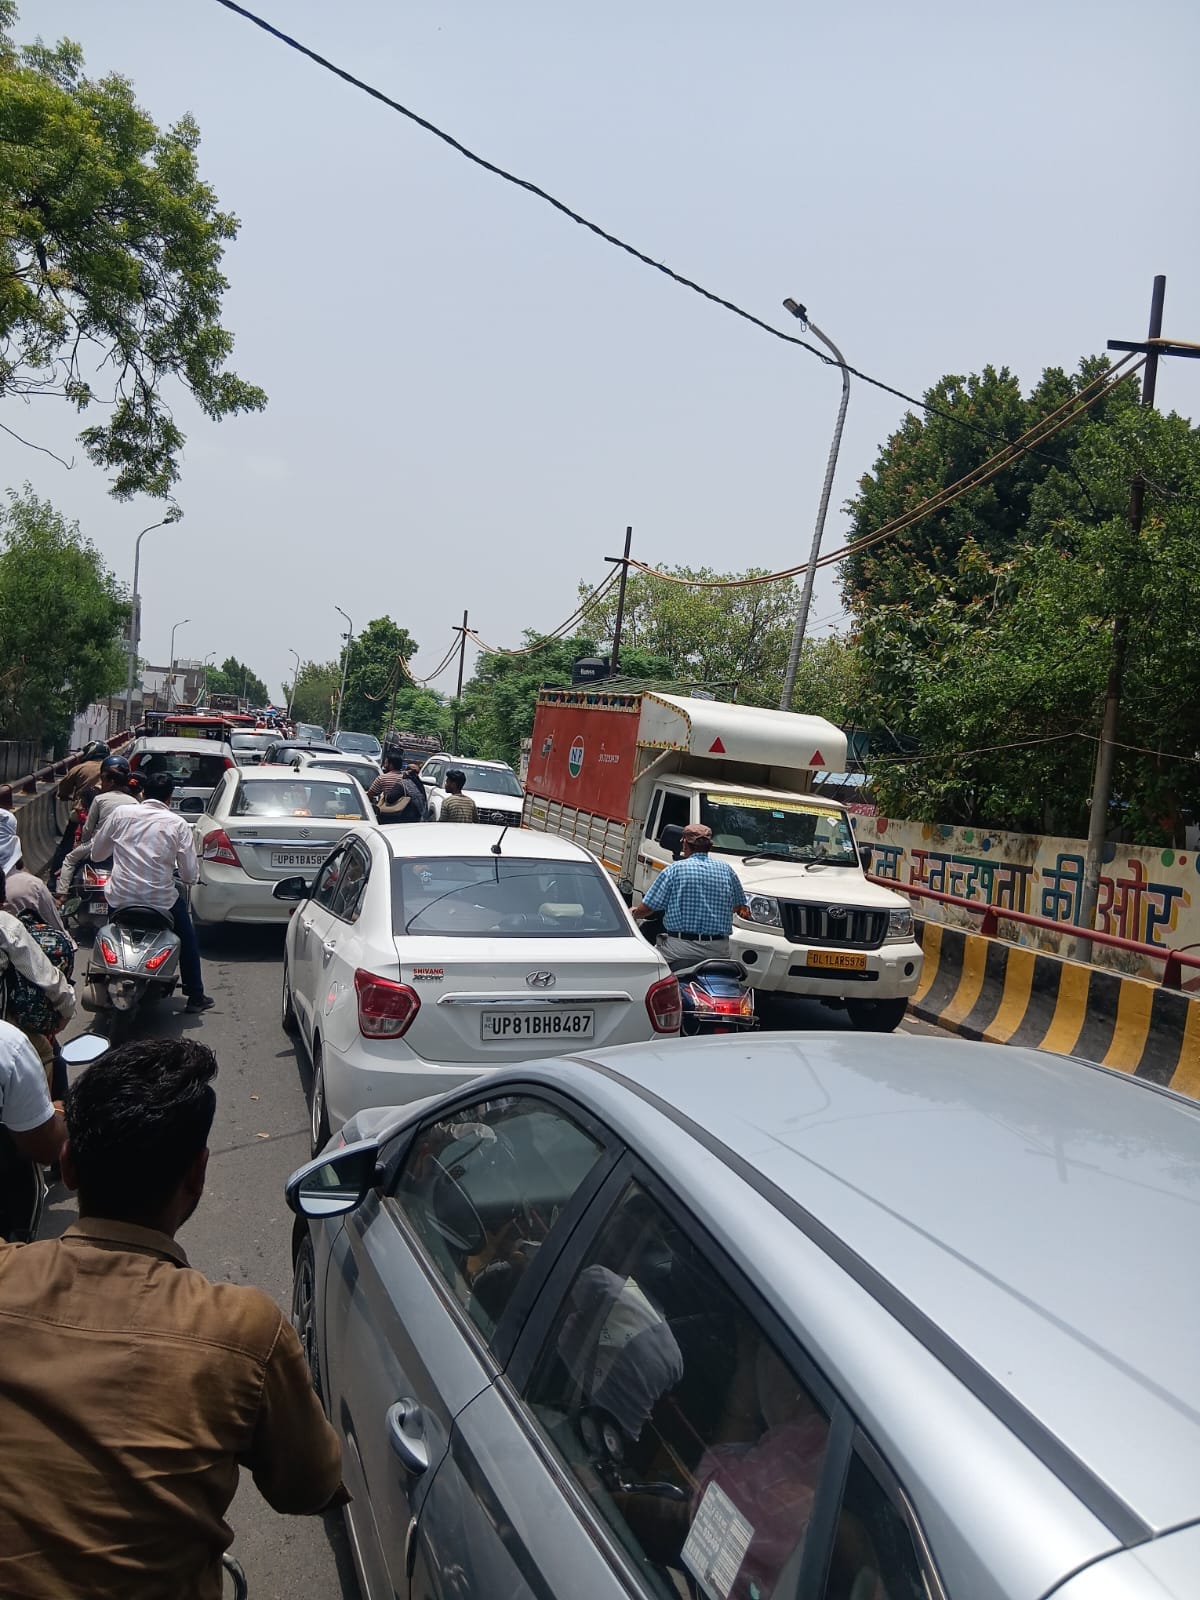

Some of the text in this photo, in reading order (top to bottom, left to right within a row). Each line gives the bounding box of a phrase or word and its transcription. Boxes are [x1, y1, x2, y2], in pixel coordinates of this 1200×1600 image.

[277, 855, 328, 865] UP81BA585
[1042, 853, 1085, 925] की
[492, 1015, 591, 1035] UP81BH8487
